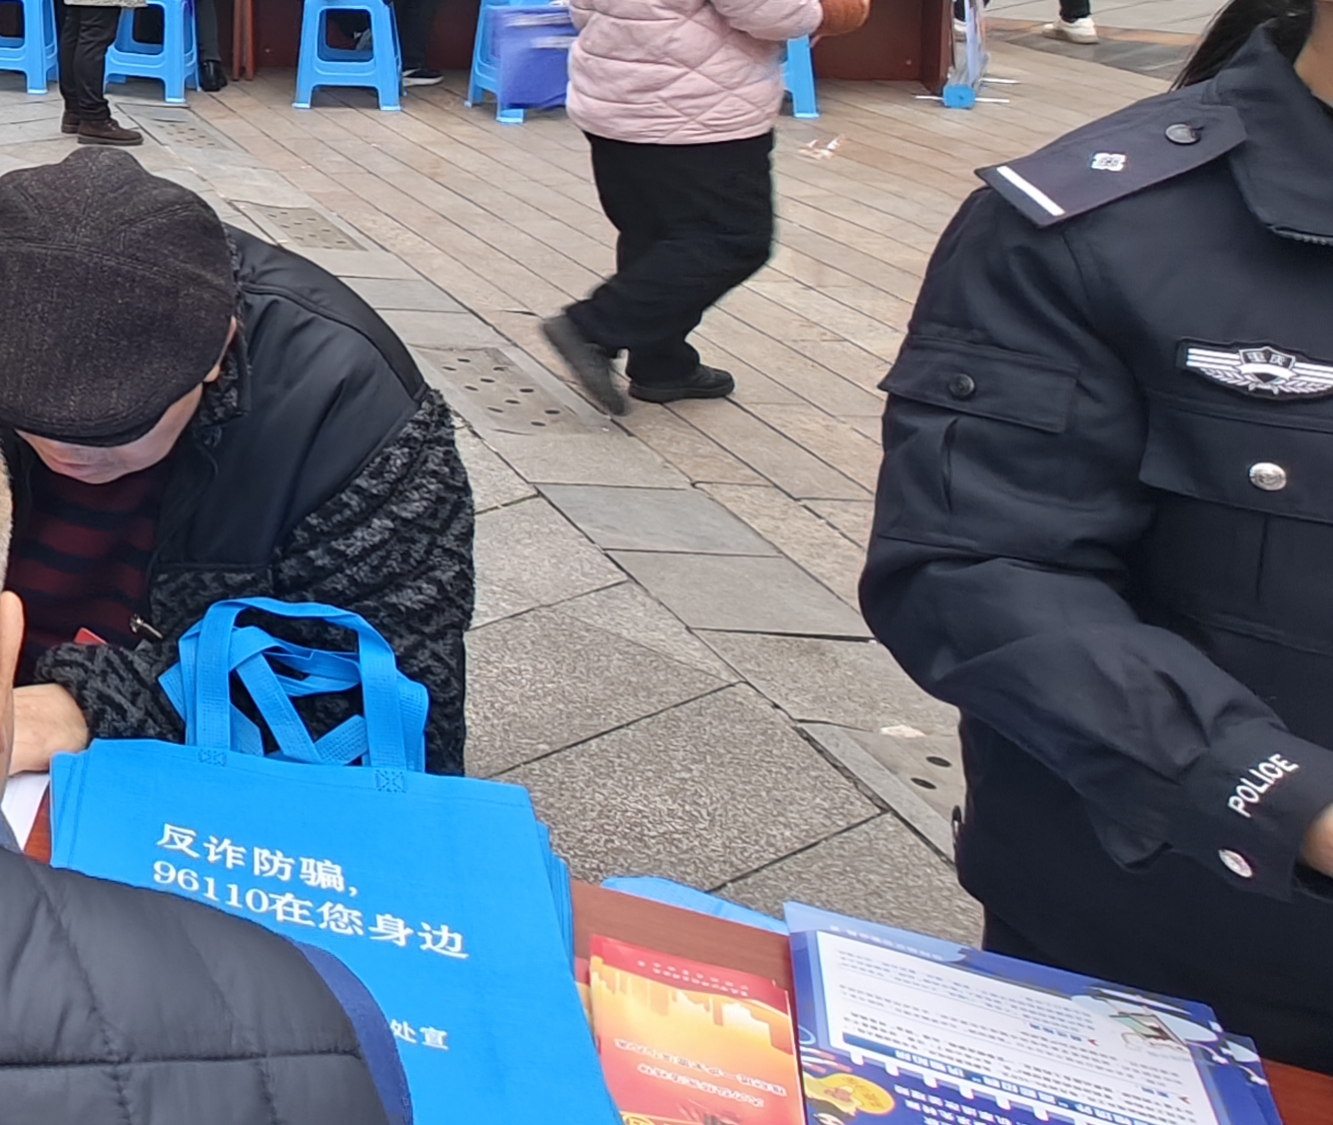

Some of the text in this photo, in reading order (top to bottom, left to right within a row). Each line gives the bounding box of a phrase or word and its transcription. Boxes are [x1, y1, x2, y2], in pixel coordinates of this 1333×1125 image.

[1226, 752, 1299, 818] POLICE
[152, 859, 470, 960] 96110在您身边
